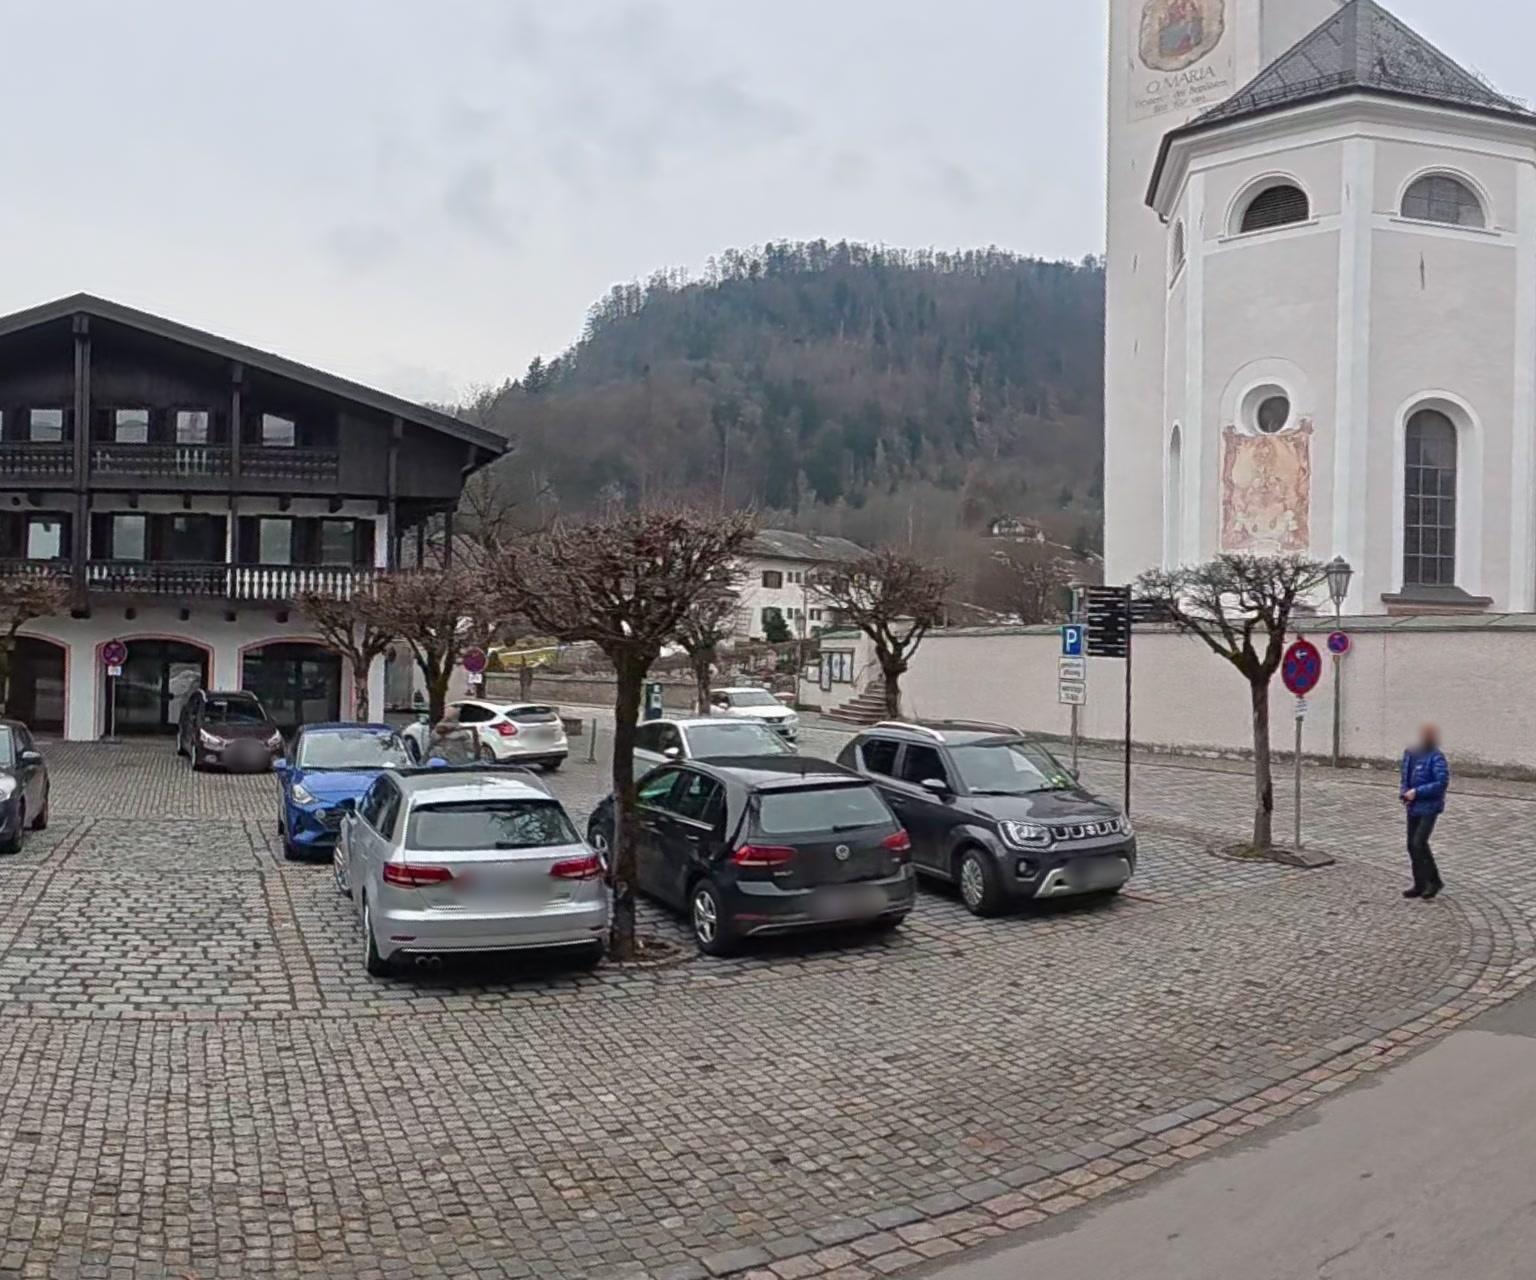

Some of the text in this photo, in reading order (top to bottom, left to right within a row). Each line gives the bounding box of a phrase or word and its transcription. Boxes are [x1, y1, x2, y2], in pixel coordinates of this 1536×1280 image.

[1146, 79, 1160, 94] O
[1163, 65, 1215, 89] MARIA
[1066, 629, 1077, 652] P
